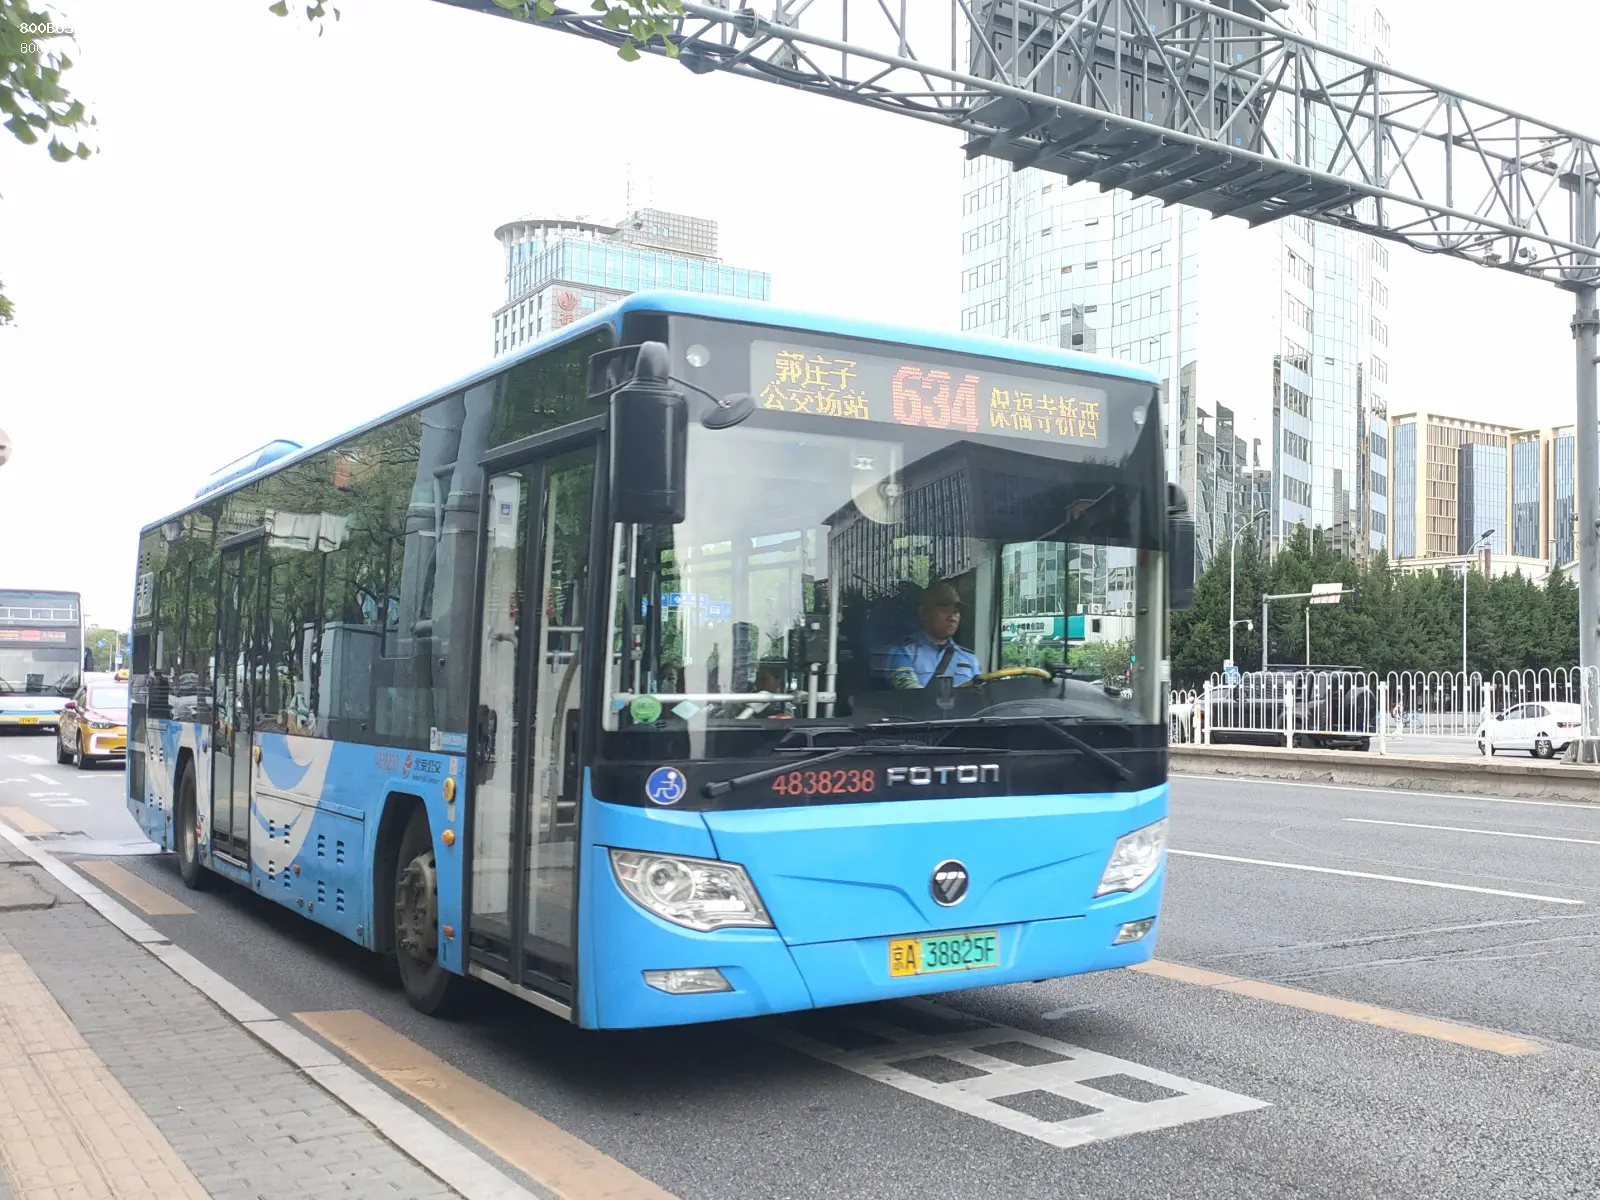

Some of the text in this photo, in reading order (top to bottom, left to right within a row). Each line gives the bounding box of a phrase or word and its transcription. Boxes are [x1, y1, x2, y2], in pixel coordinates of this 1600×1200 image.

[775, 350, 858, 389] 郭庄子
[759, 379, 869, 420] 公交场站
[892, 365, 980, 433] 634
[771, 768, 876, 796] 4838238
[886, 763, 1000, 786] FOTON
